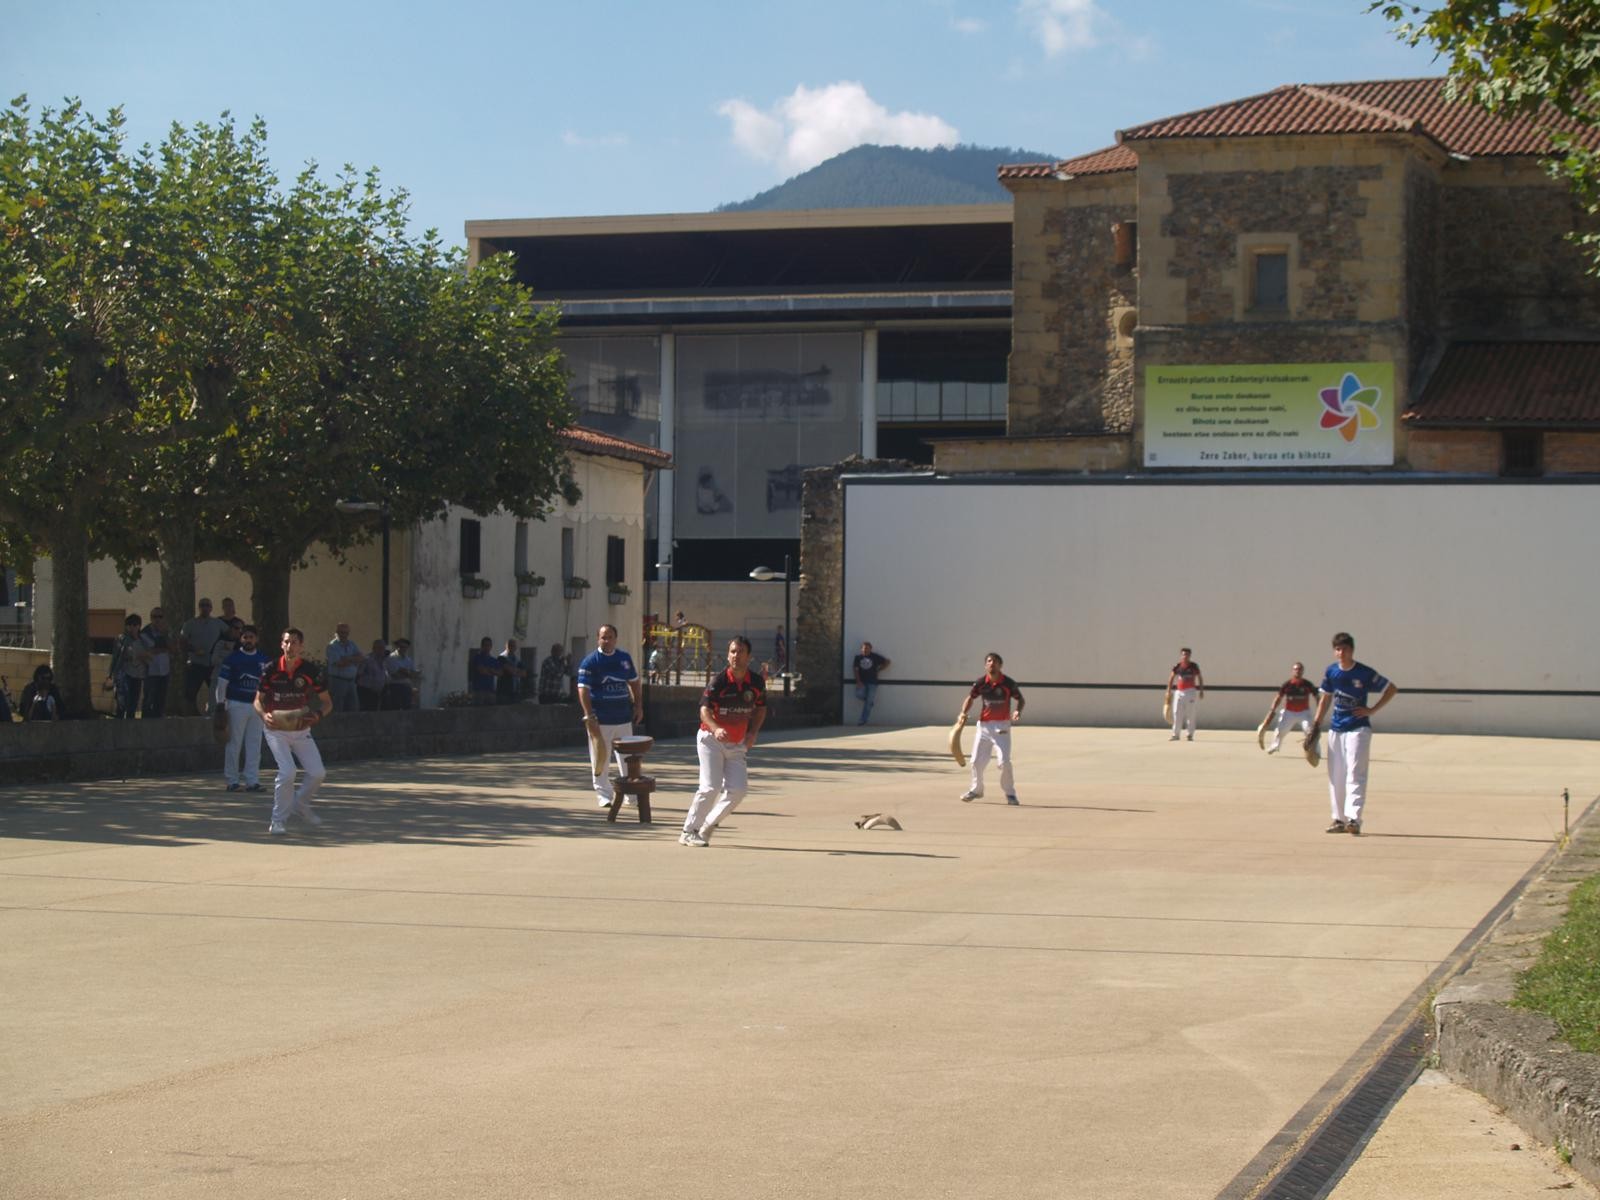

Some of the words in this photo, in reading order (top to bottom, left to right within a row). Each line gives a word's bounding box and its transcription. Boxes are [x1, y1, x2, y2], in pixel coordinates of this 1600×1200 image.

[1200, 451, 1220, 460] Zero
[1252, 451, 1278, 460] burua
[1281, 452, 1296, 460] eta
[1298, 451, 1332, 460] bihotza
